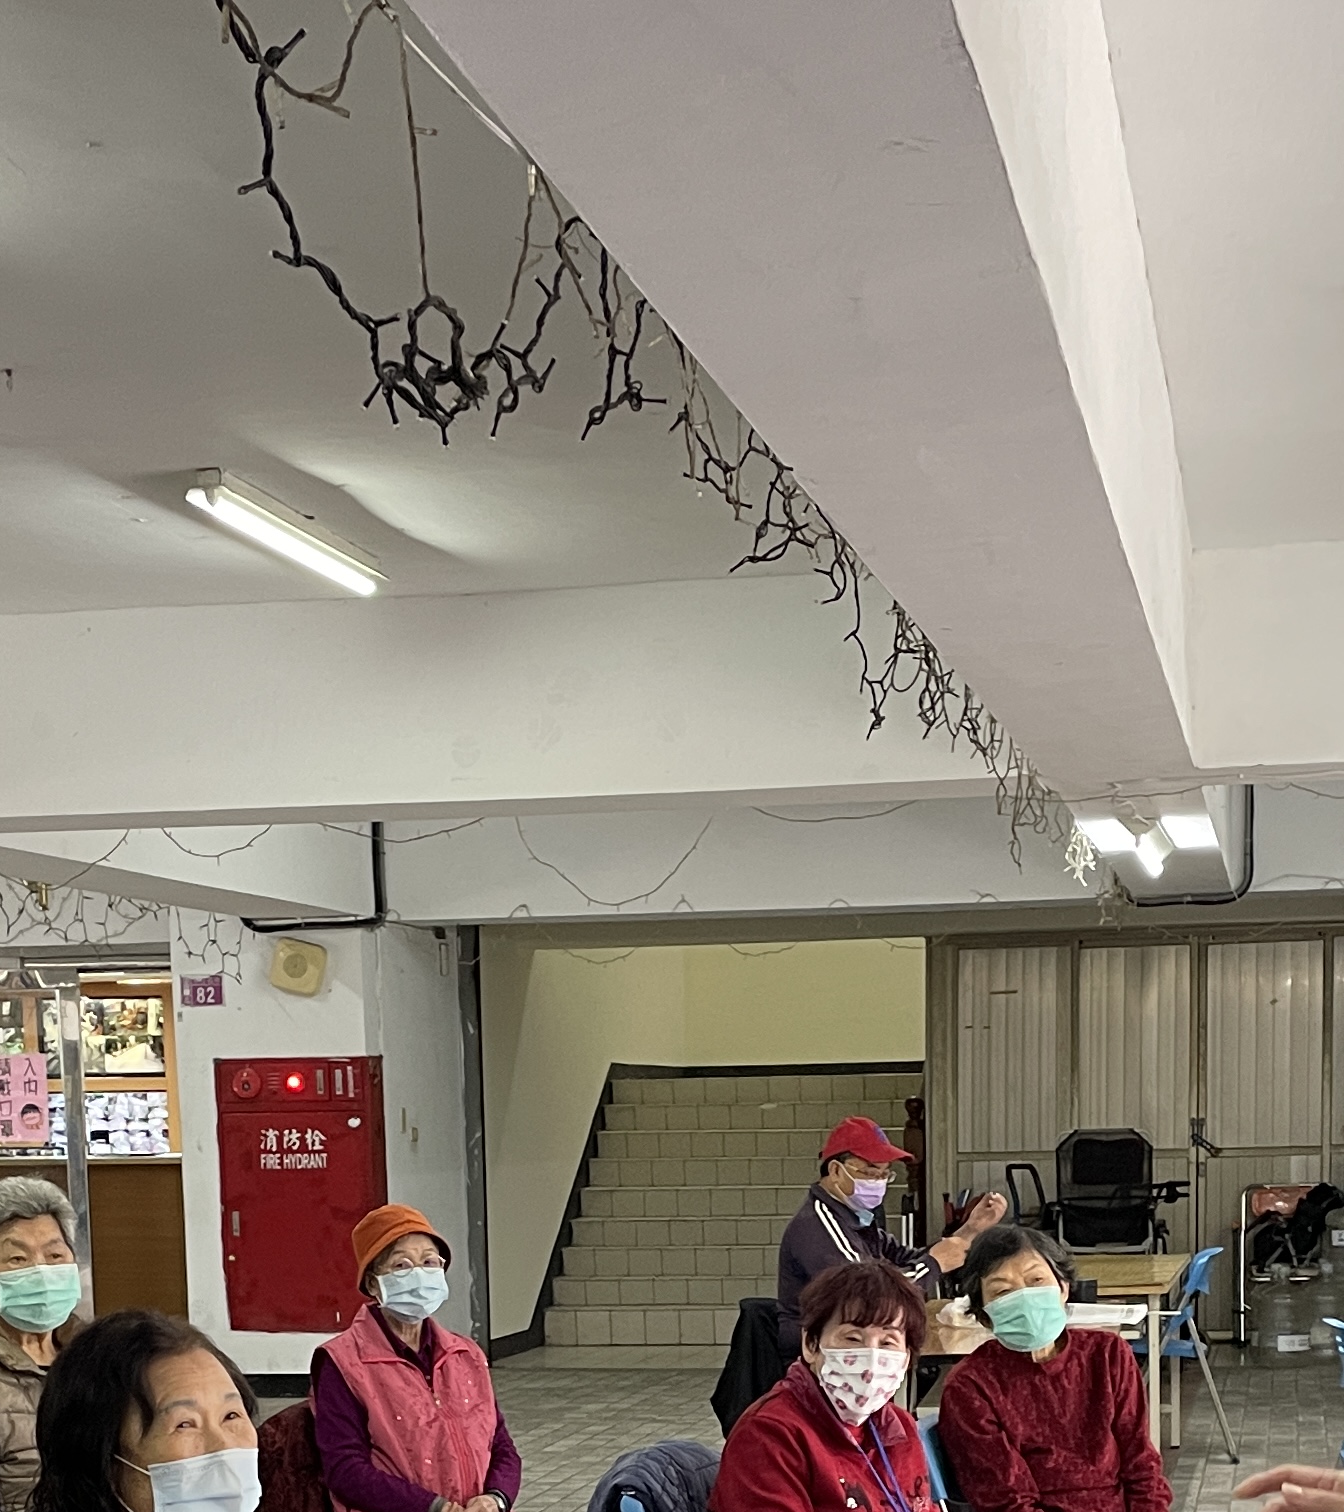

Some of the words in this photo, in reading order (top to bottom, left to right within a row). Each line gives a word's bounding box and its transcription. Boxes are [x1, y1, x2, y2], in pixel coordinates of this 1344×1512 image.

[196, 986, 216, 1004] 82
[260, 1128, 327, 1152] 消防栓
[260, 1153, 281, 1170] FIRE
[283, 1152, 328, 1169] HYDRANT
